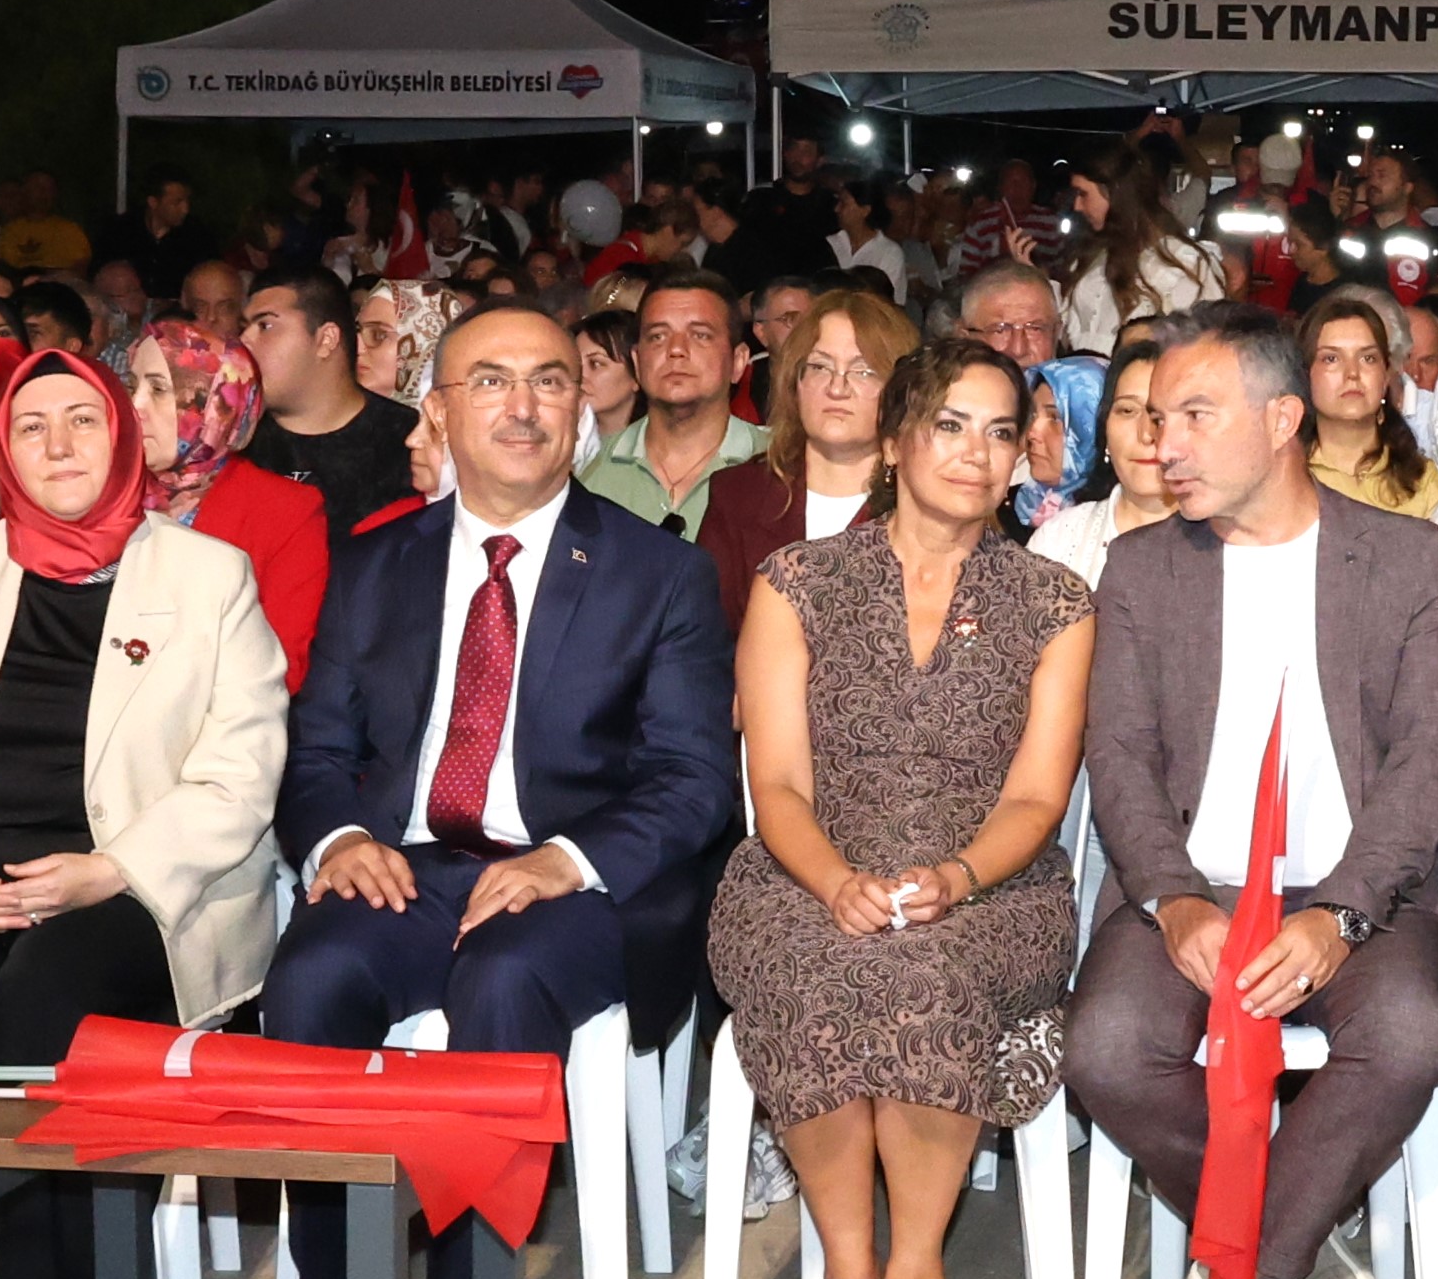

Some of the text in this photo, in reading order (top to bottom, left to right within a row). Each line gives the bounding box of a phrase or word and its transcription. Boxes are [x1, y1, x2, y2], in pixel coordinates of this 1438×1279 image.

[188, 74, 220, 92] T.C.
[225, 69, 318, 92] TEKİRDAĞ
[324, 69, 445, 96] BÜYÜKŞEHİR
[451, 70, 552, 92] BELEDİYESİ
